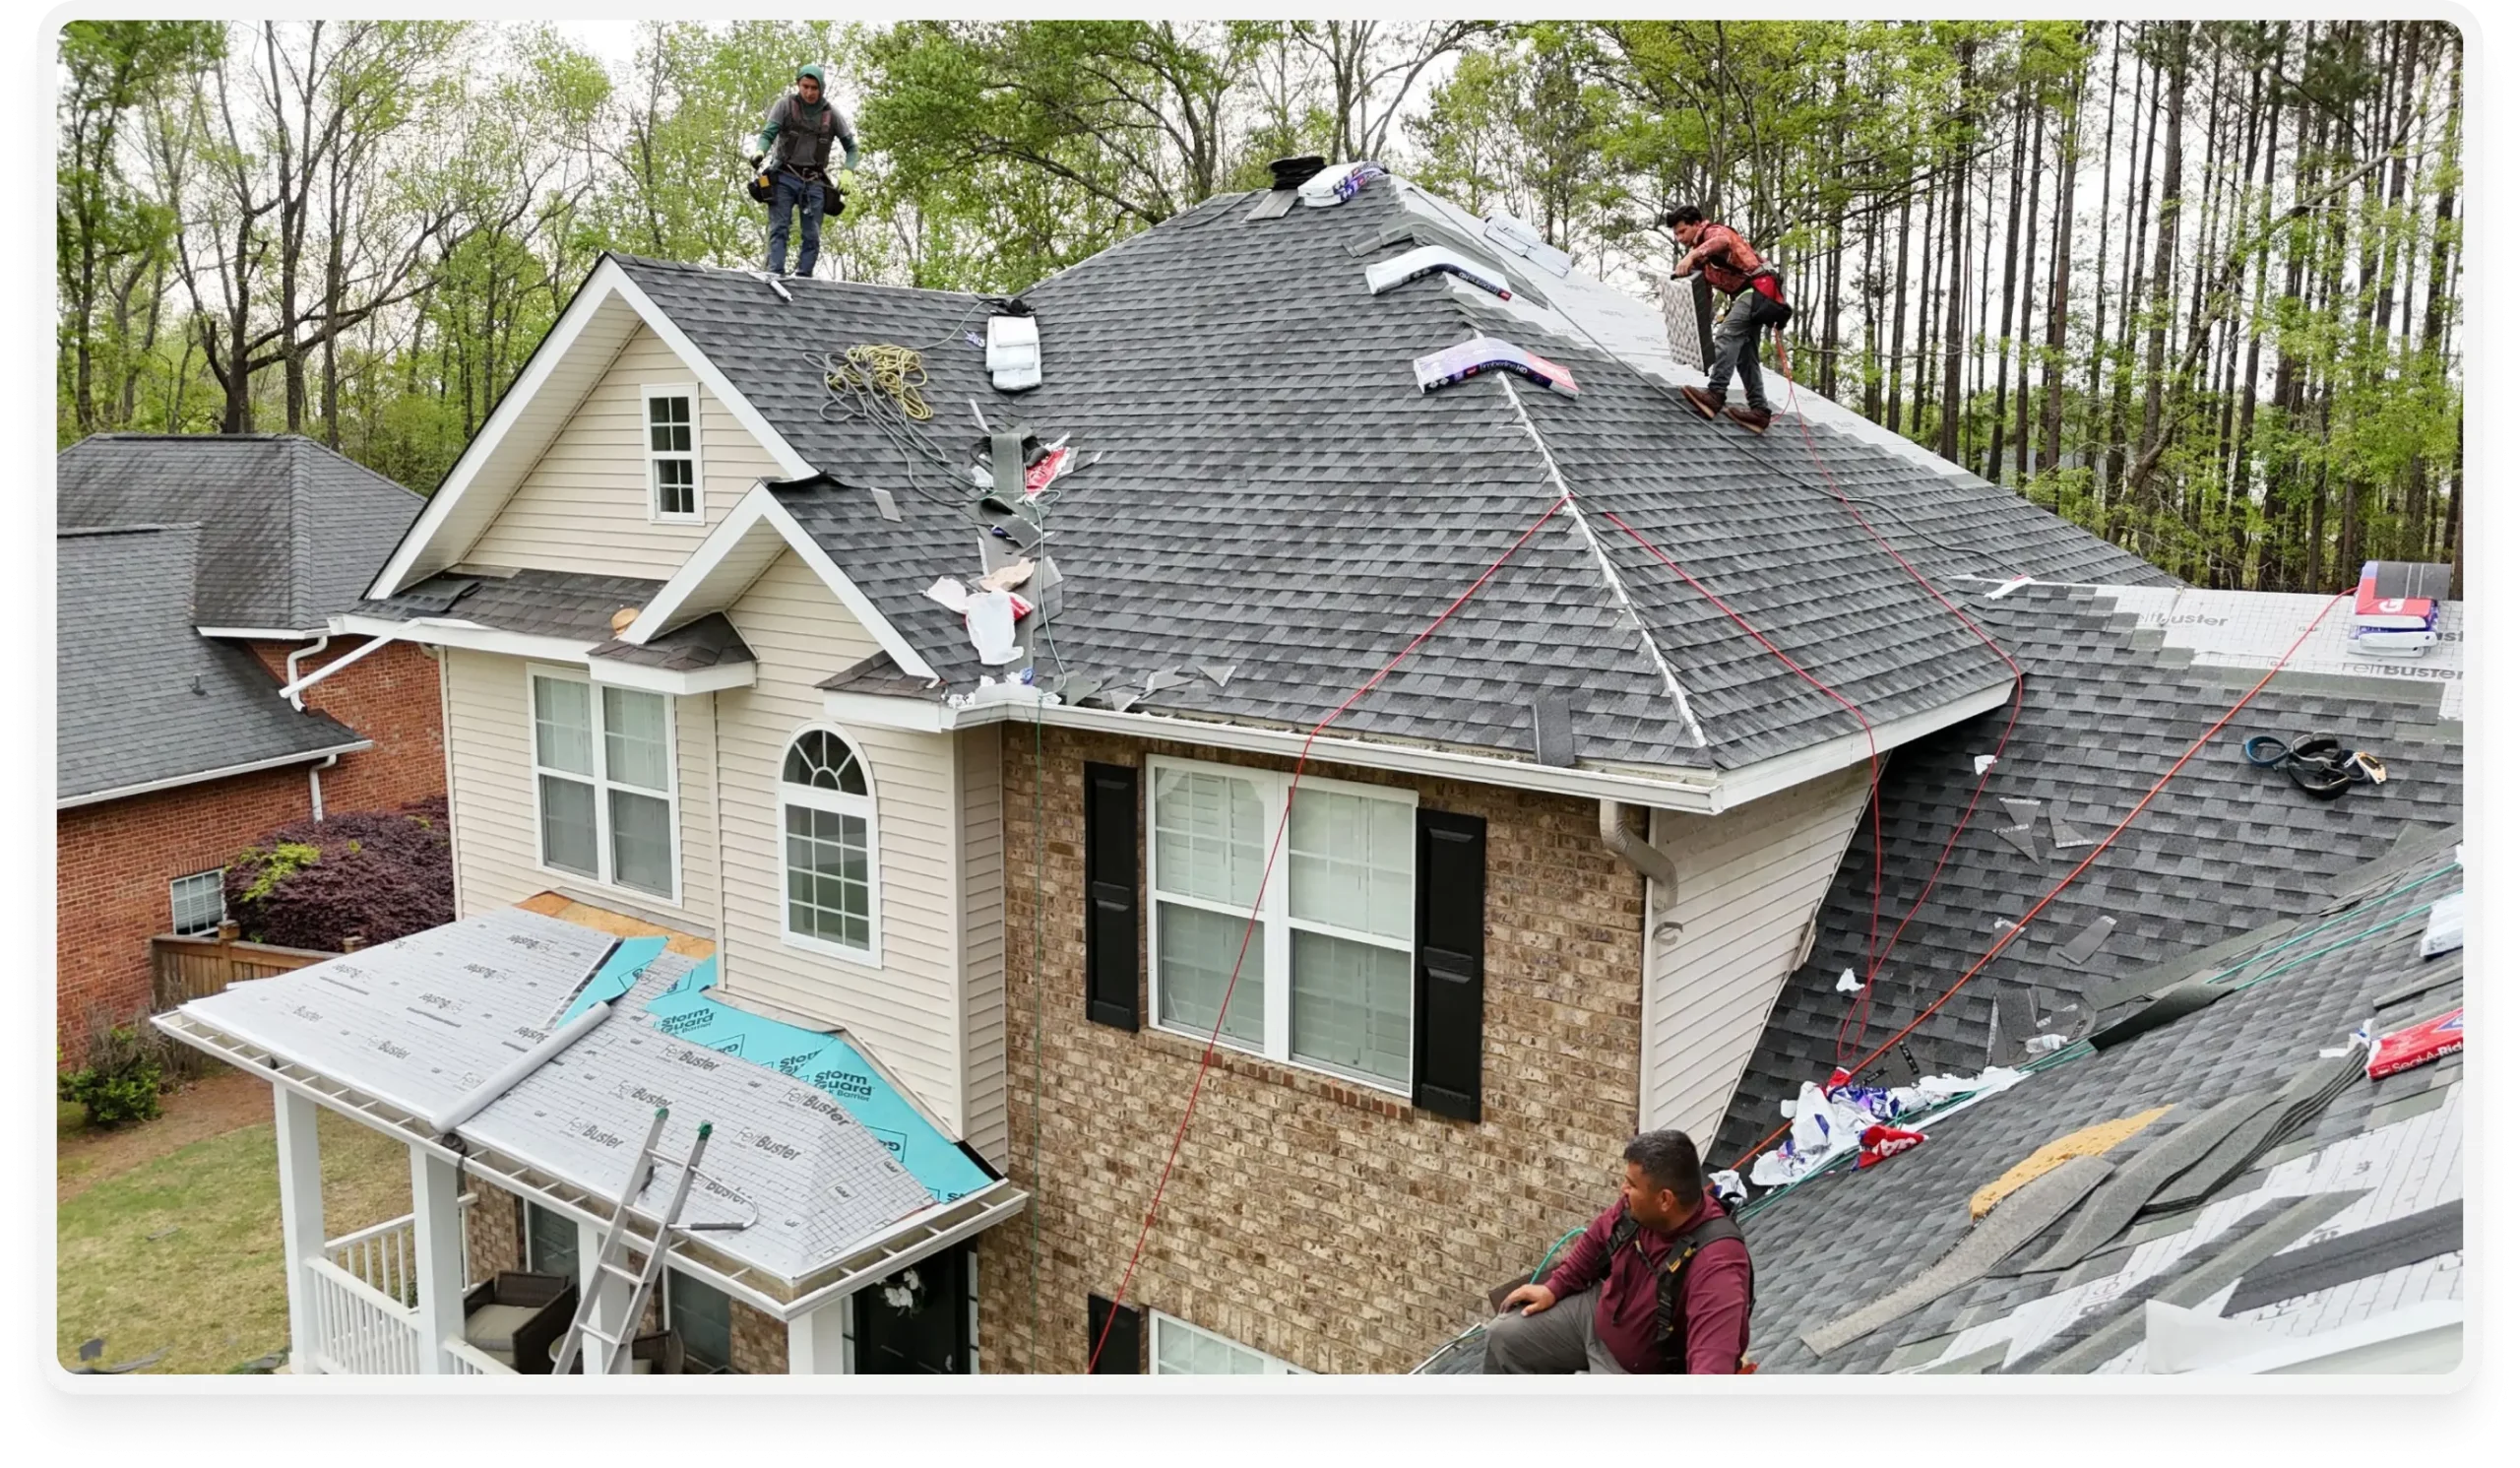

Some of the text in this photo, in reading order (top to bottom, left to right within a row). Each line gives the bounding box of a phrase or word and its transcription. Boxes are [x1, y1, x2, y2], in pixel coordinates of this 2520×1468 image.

[661, 1012, 715, 1034] Guard
[662, 1007, 710, 1025] Storm
[661, 1044, 721, 1071] FeltBuster
[813, 1079, 874, 1097] Guard
[814, 1070, 868, 1086] Storm
[782, 1087, 850, 1127] FeltBuster
[566, 1117, 624, 1150] FeltBuster
[734, 1126, 801, 1161] FeltBuster
[693, 1172, 752, 1205] eltBuster
